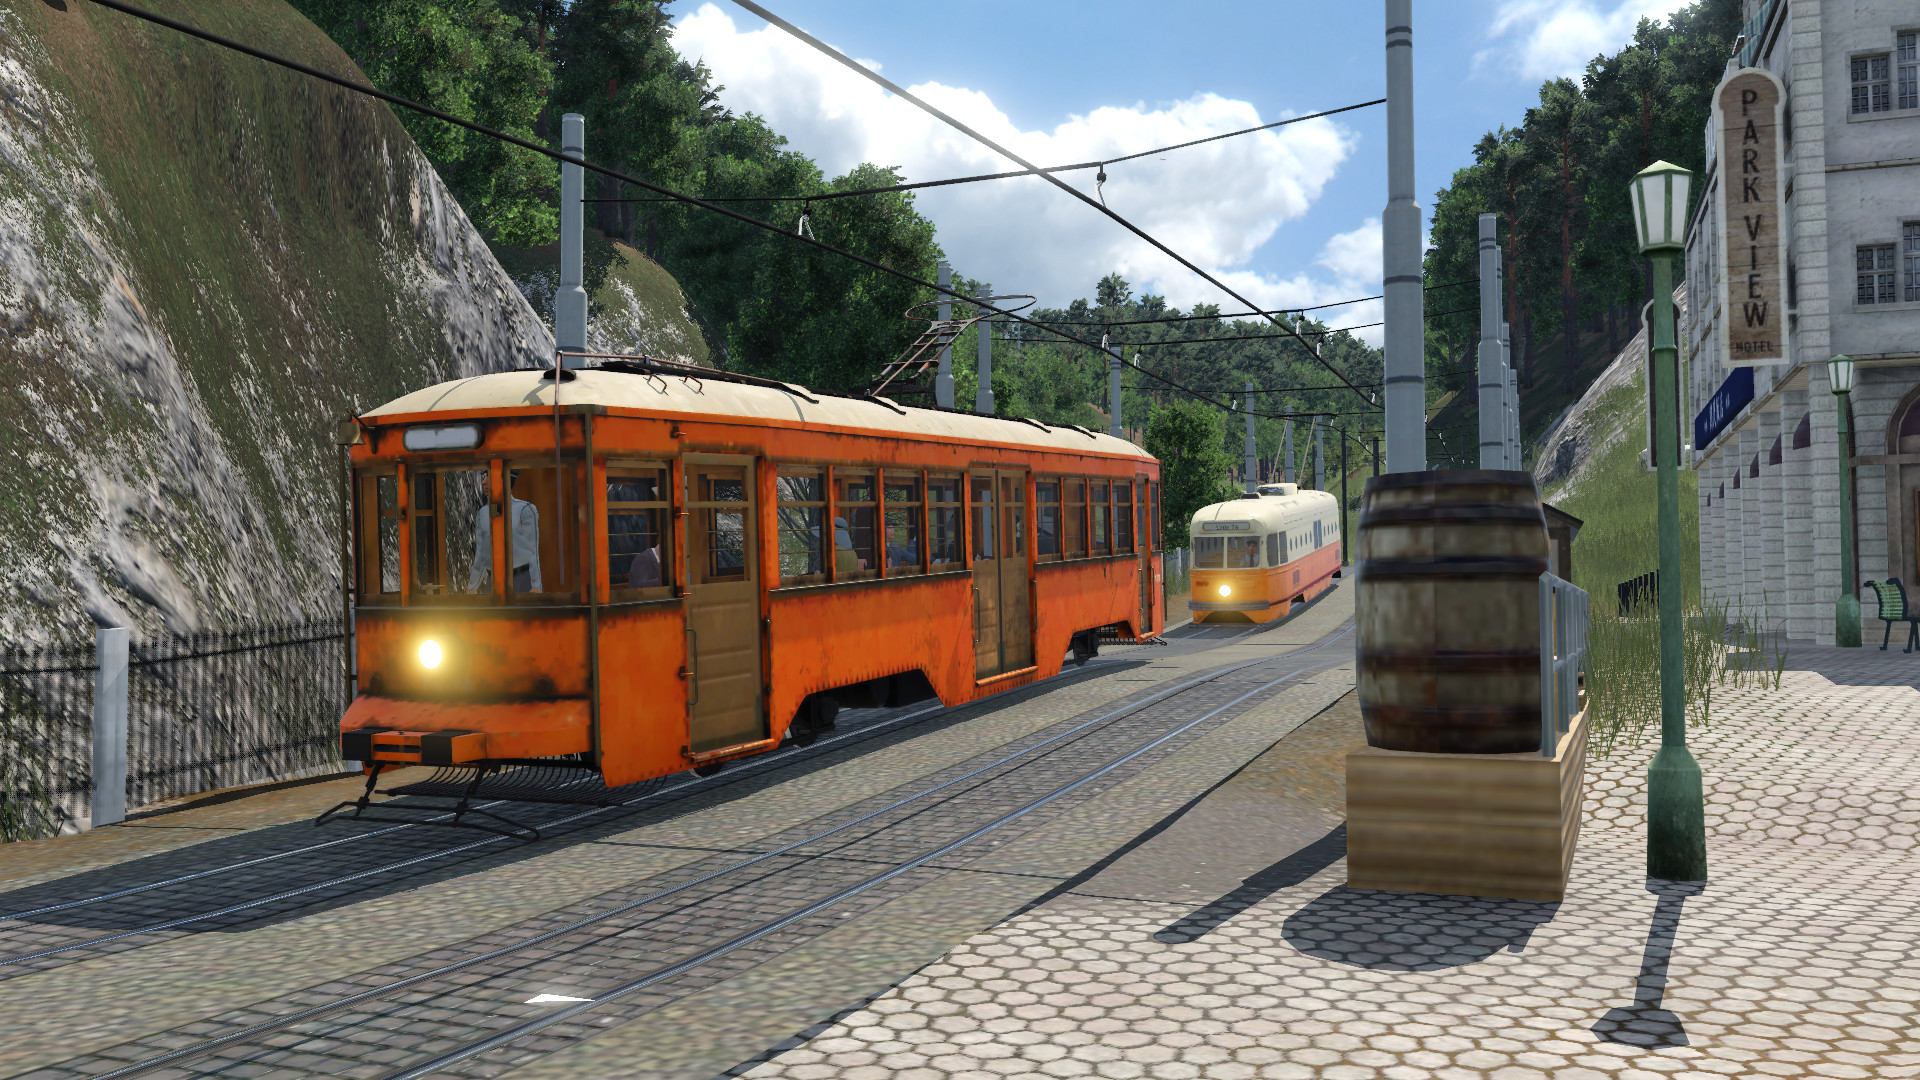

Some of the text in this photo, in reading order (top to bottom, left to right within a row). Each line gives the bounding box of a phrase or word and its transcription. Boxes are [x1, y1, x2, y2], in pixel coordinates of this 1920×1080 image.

[1742, 89, 1768, 328] PARK VIEW
[1735, 340, 1774, 353] HOTEL
